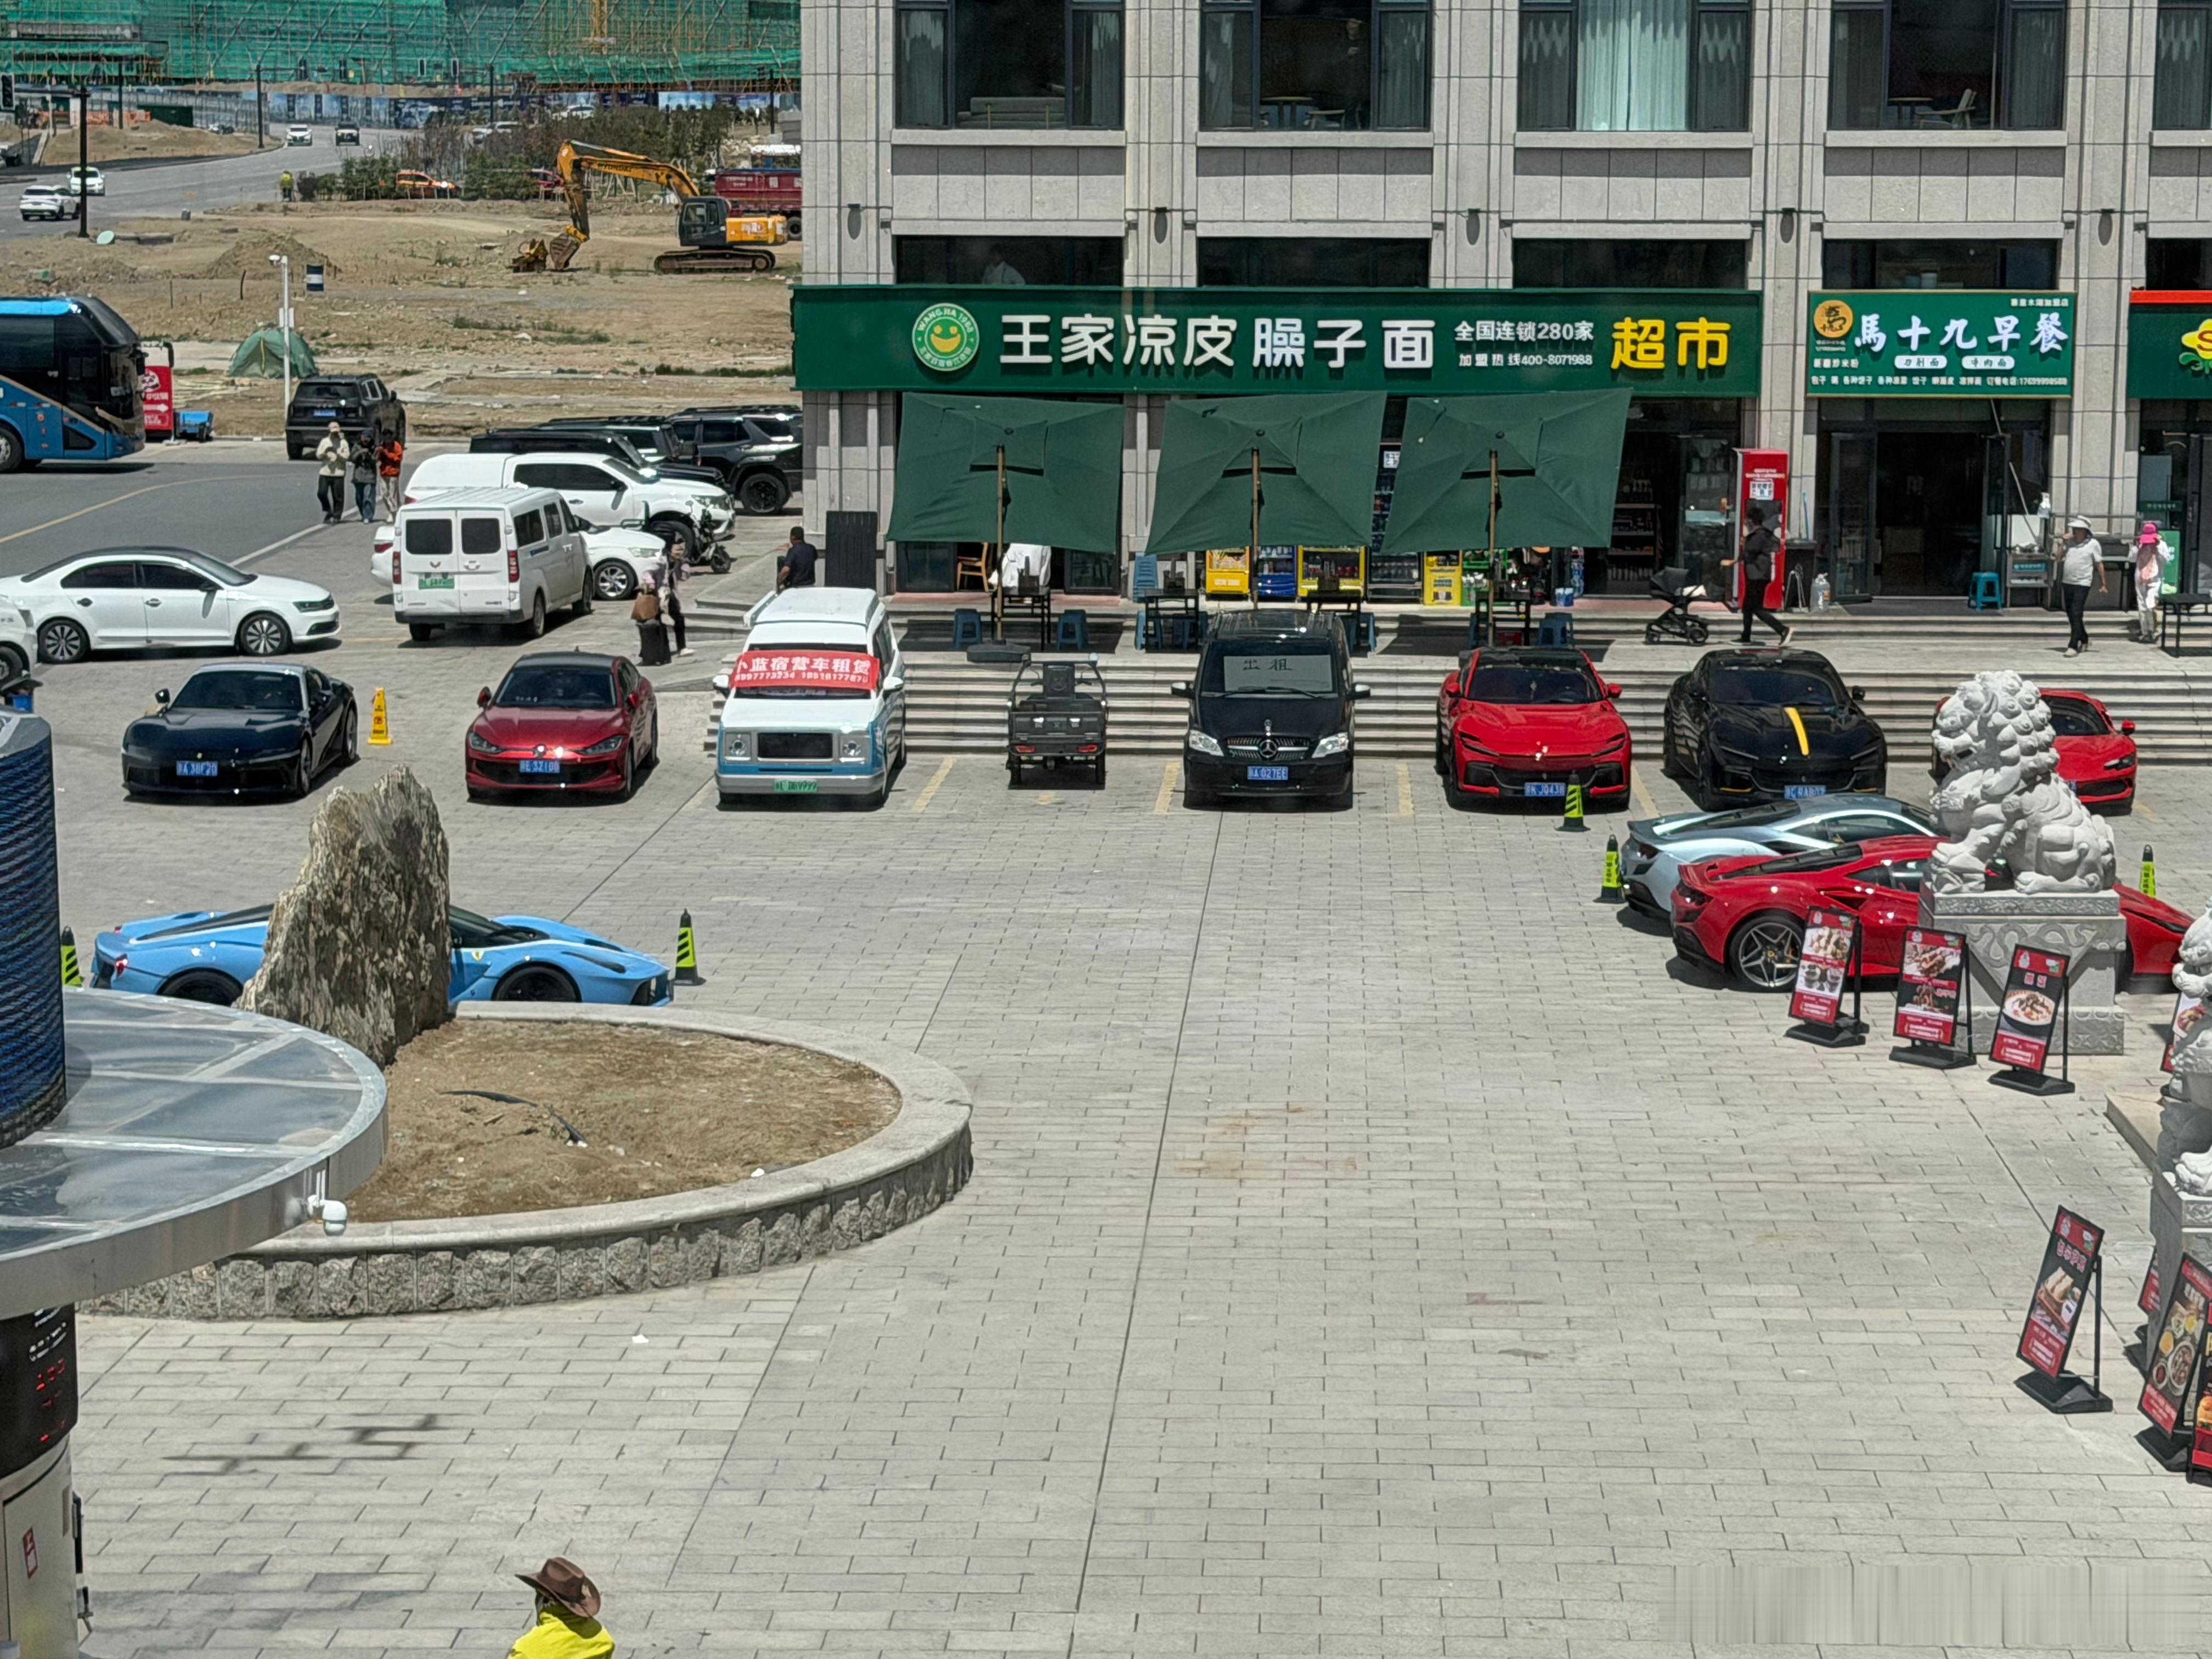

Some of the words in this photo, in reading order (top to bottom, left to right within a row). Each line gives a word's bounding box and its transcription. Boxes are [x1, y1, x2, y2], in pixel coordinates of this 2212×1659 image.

[917, 308, 943, 331] WANG
[1454, 320, 1594, 342] 全国连锁280家
[1610, 317, 1731, 369] 超市
[1854, 312, 2069, 354] 馬十九早餐
[1243, 658, 1293, 672] 出租
